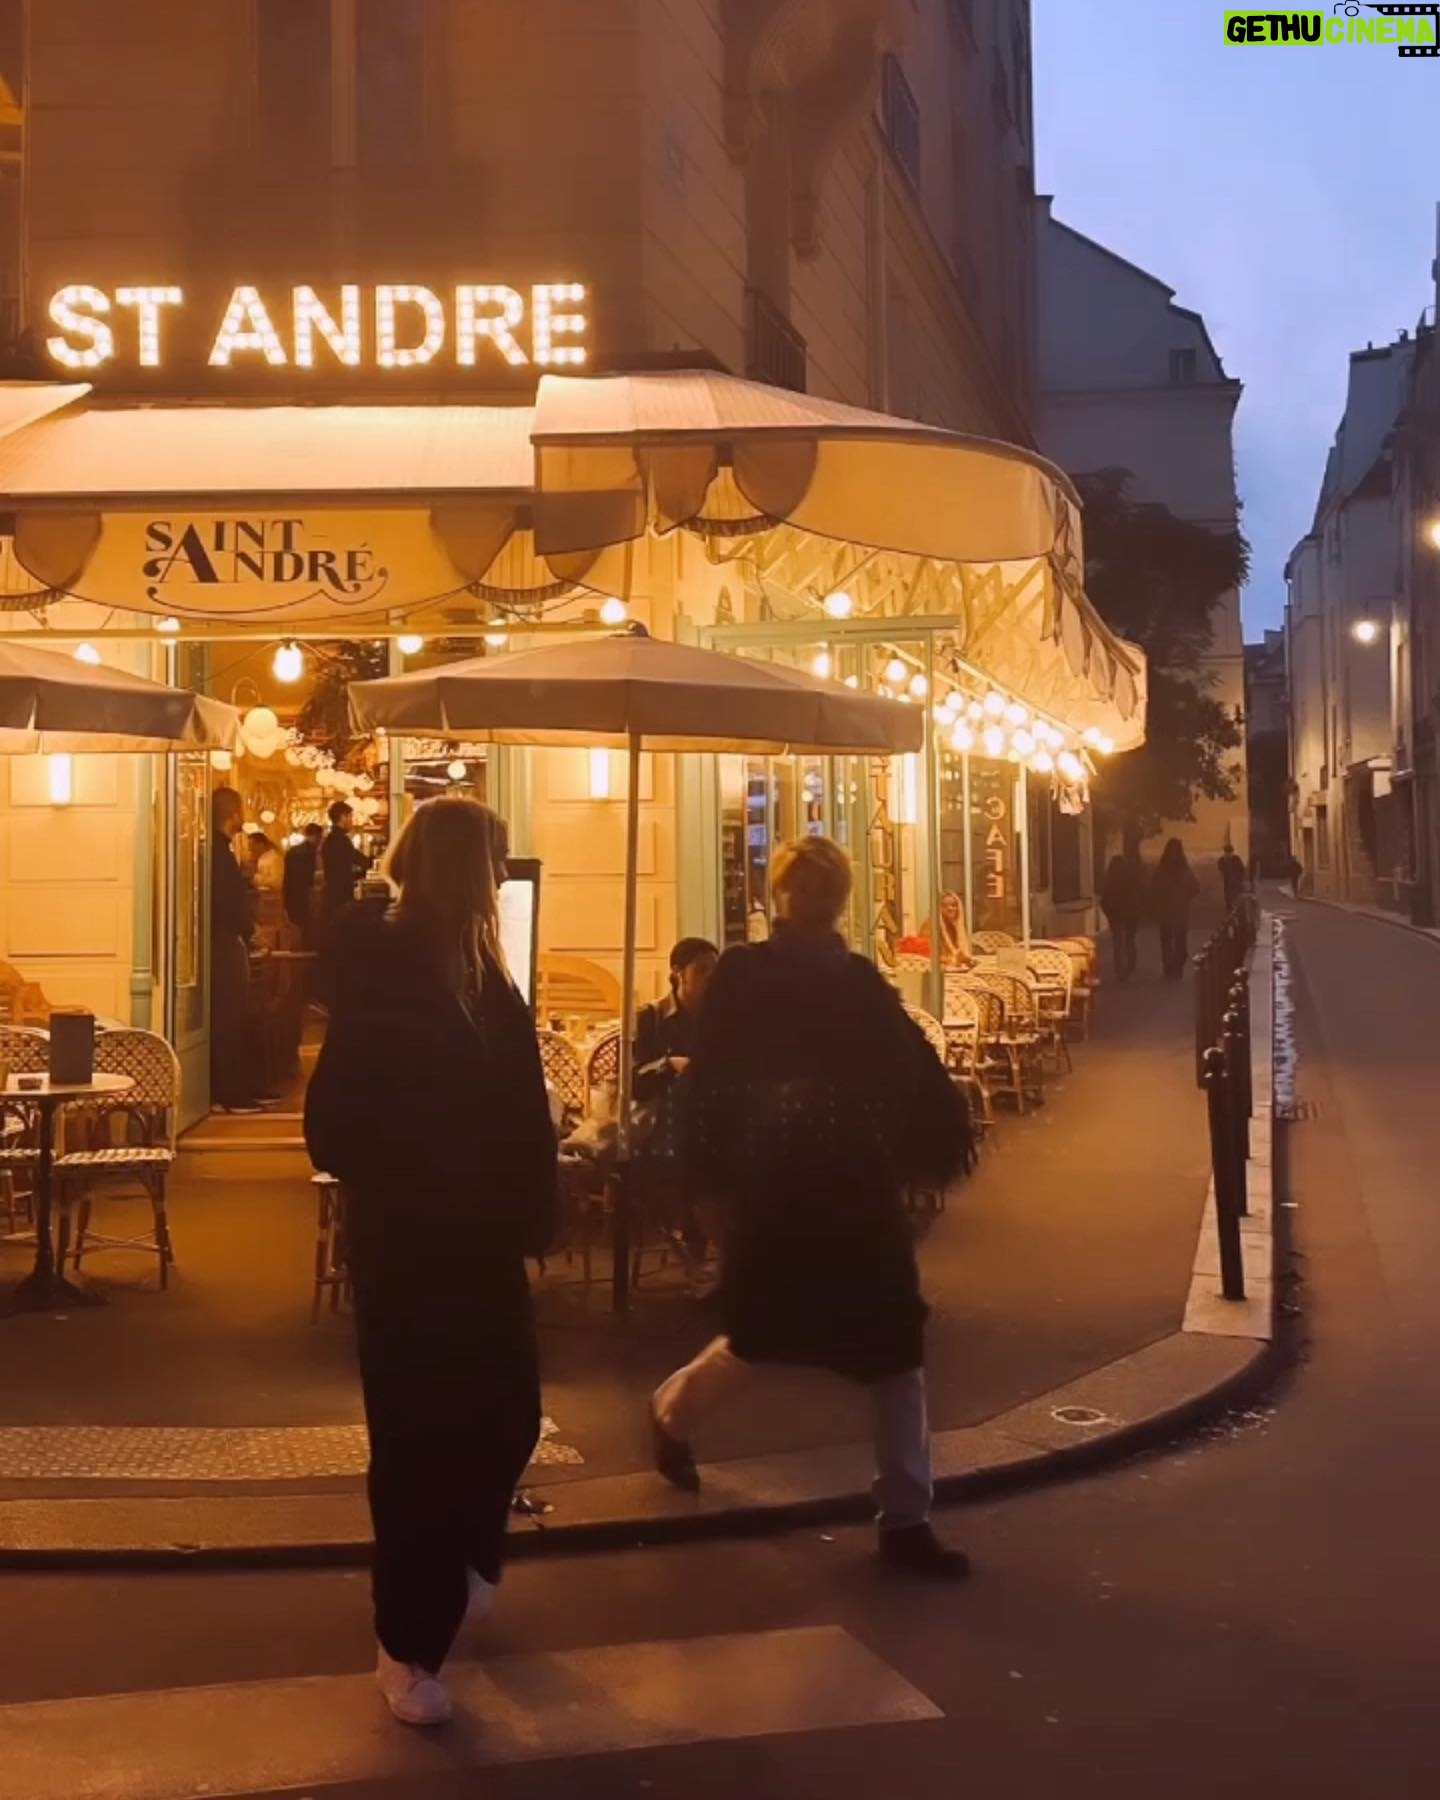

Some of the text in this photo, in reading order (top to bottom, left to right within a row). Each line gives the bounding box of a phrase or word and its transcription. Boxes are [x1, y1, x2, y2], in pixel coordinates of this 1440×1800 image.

[46, 281, 587, 368] ST ANDRE
[143, 522, 374, 593] ANDRÉ
